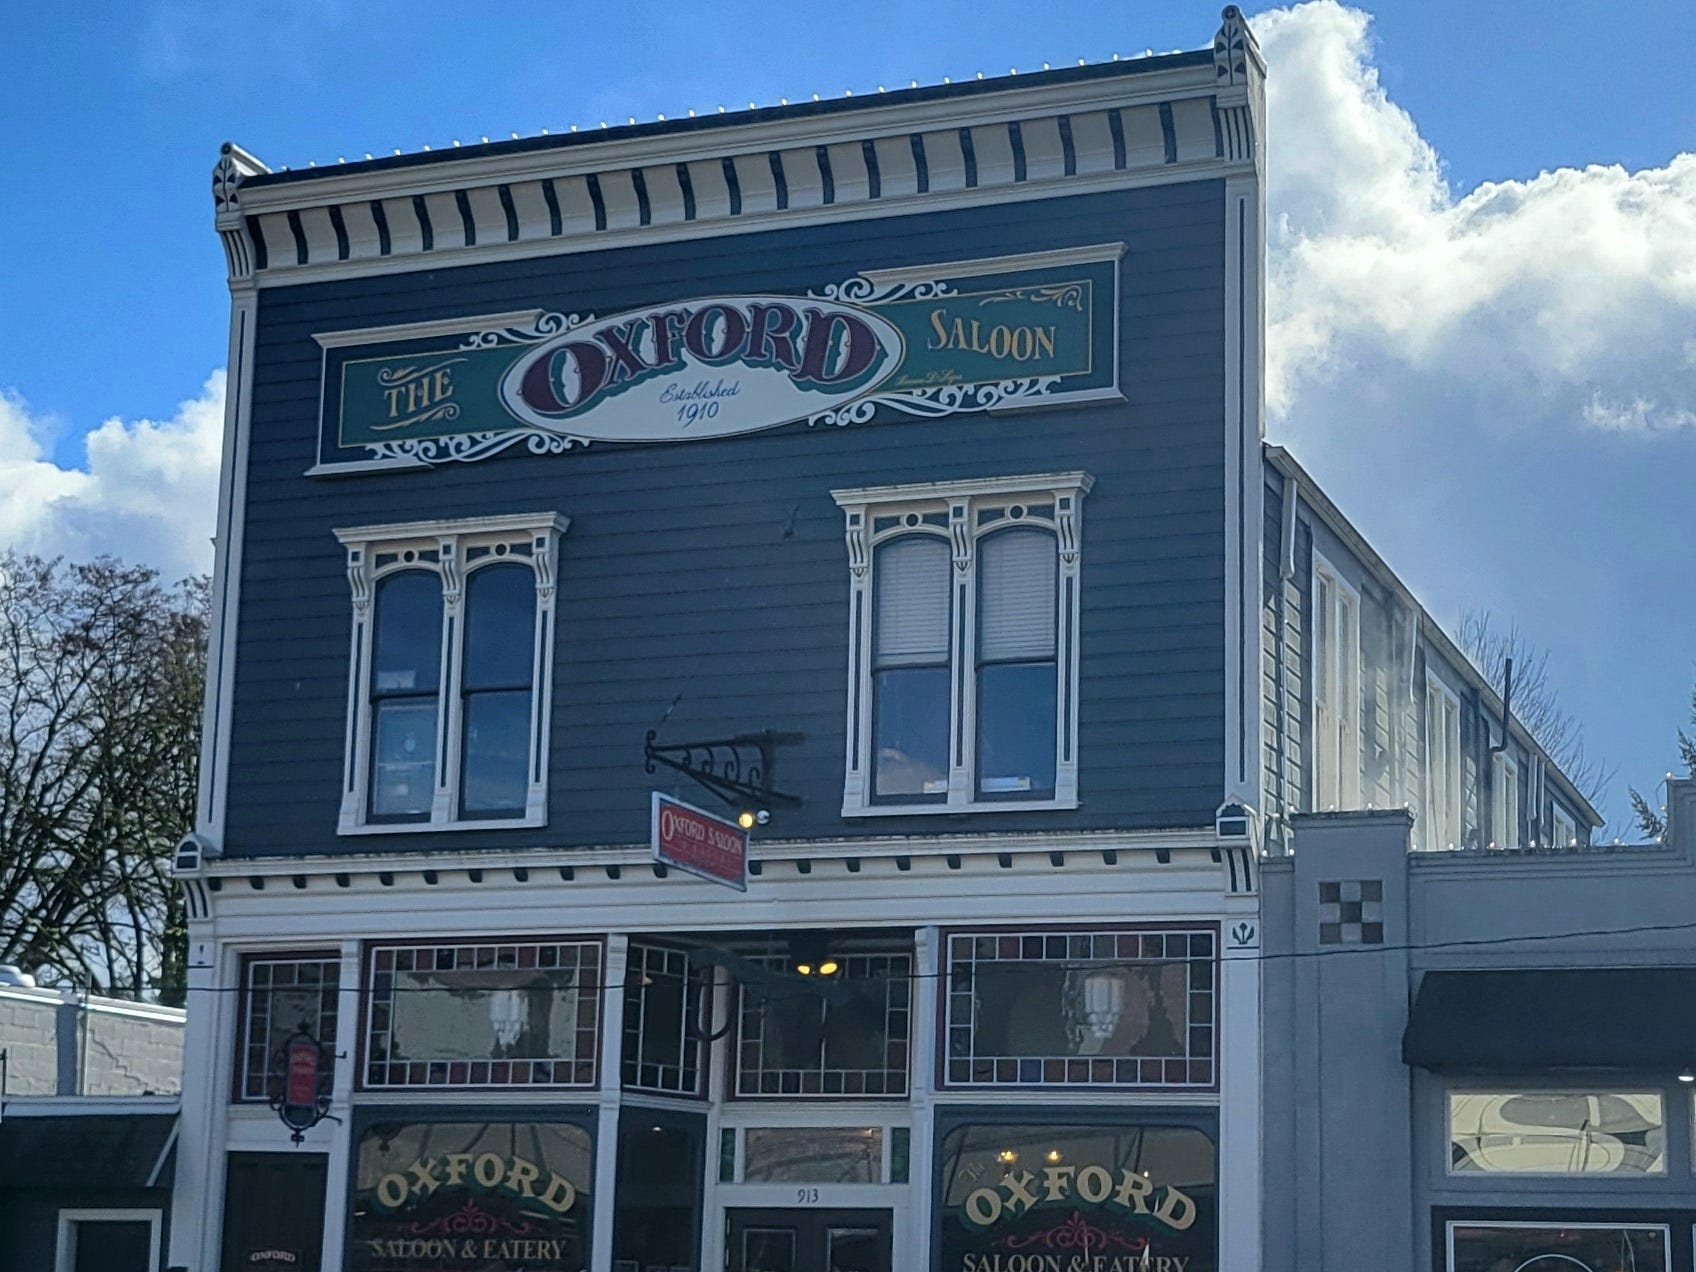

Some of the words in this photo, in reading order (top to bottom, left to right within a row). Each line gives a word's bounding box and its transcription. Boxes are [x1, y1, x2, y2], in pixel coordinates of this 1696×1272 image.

[384, 367, 454, 419] THE
[517, 302, 889, 419] OXFORD
[927, 308, 1055, 362] SALOON
[660, 379, 741, 404] Established
[677, 401, 719, 429] 1910
[661, 810, 705, 841] OXFORD
[707, 828, 743, 854] SALOON
[377, 1152, 576, 1213] OXFORD
[797, 1189, 819, 1203] 913
[965, 1165, 1197, 1231] OXFORD
[372, 1238, 456, 1259] SALOON
[461, 1238, 478, 1259] &
[484, 1239, 567, 1260] EATERY
[963, 1252, 1062, 1272] SALOON
